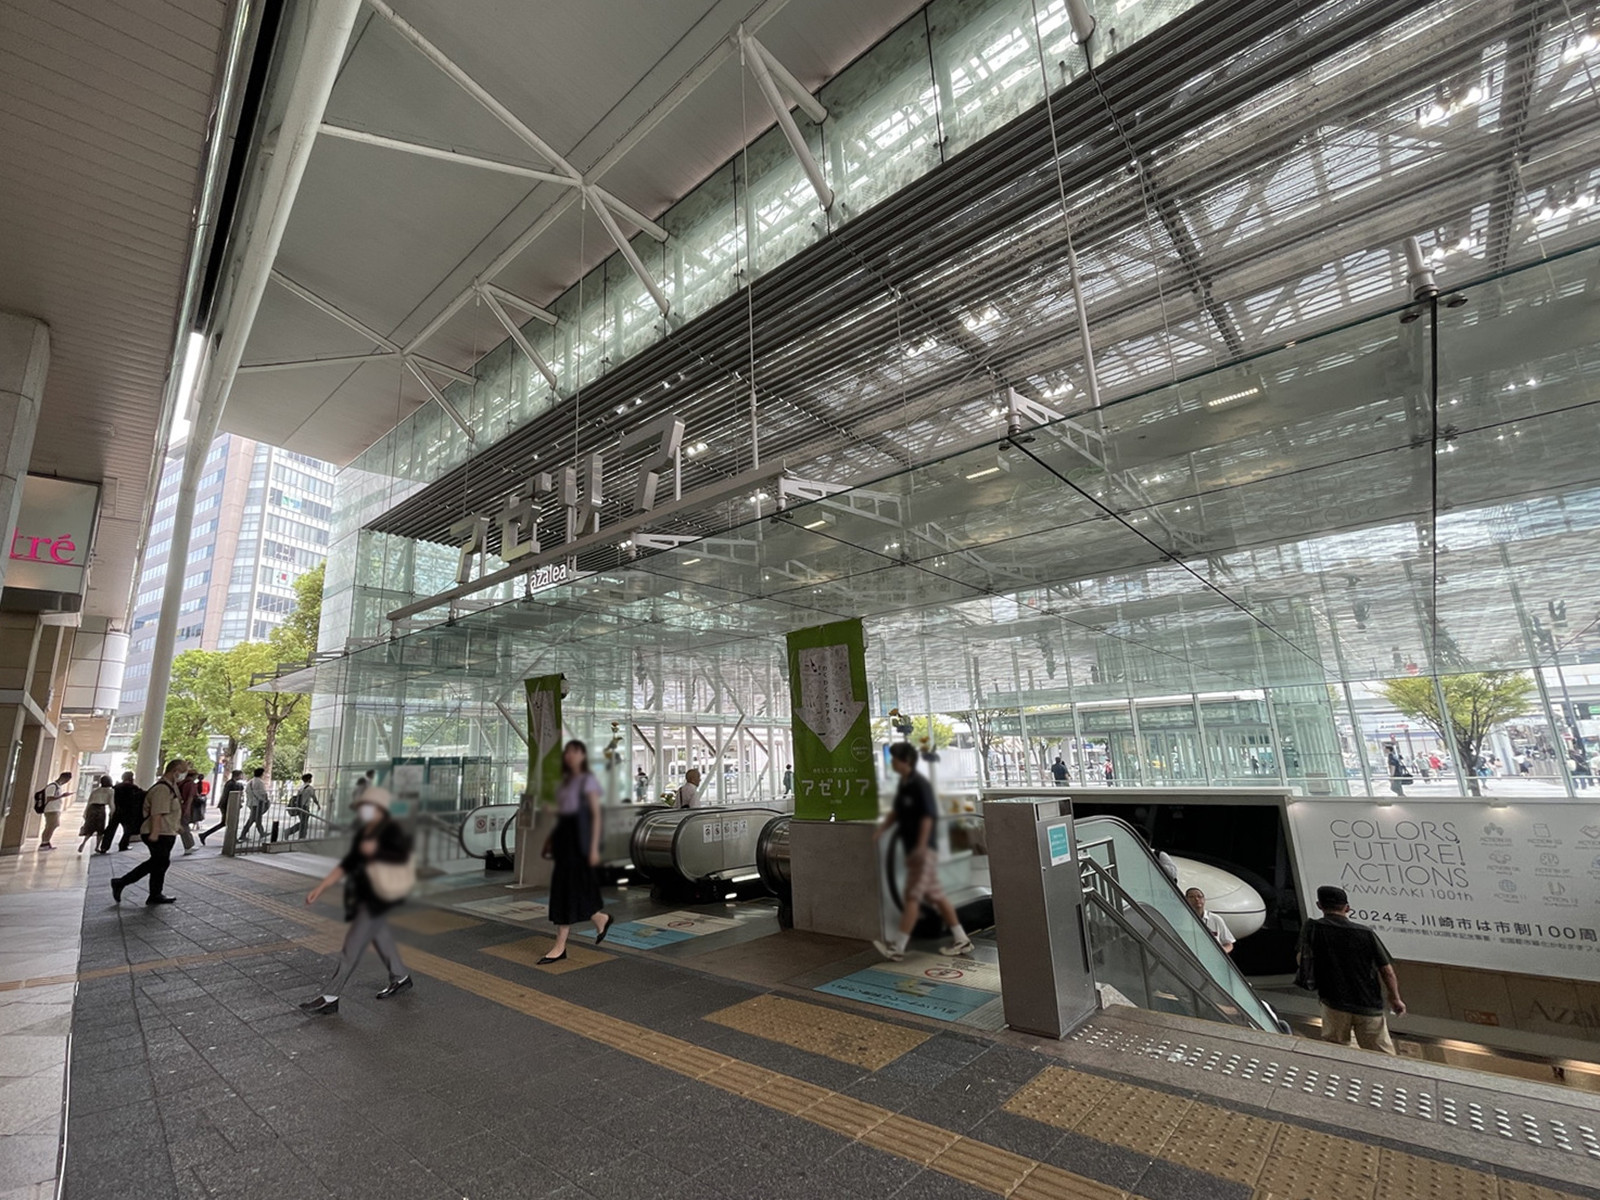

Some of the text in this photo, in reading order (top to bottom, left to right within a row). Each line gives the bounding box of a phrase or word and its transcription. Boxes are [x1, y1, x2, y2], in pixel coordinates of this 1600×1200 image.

[450, 414, 686, 584] アゼリア
[530, 563, 568, 589] azalea
[802, 778, 869, 796] アゼリア
[1333, 840, 1466, 866] FUTURE!
[1341, 862, 1469, 888] ACTIONS
[1342, 883, 1473, 901] KAWASAKI 100th
